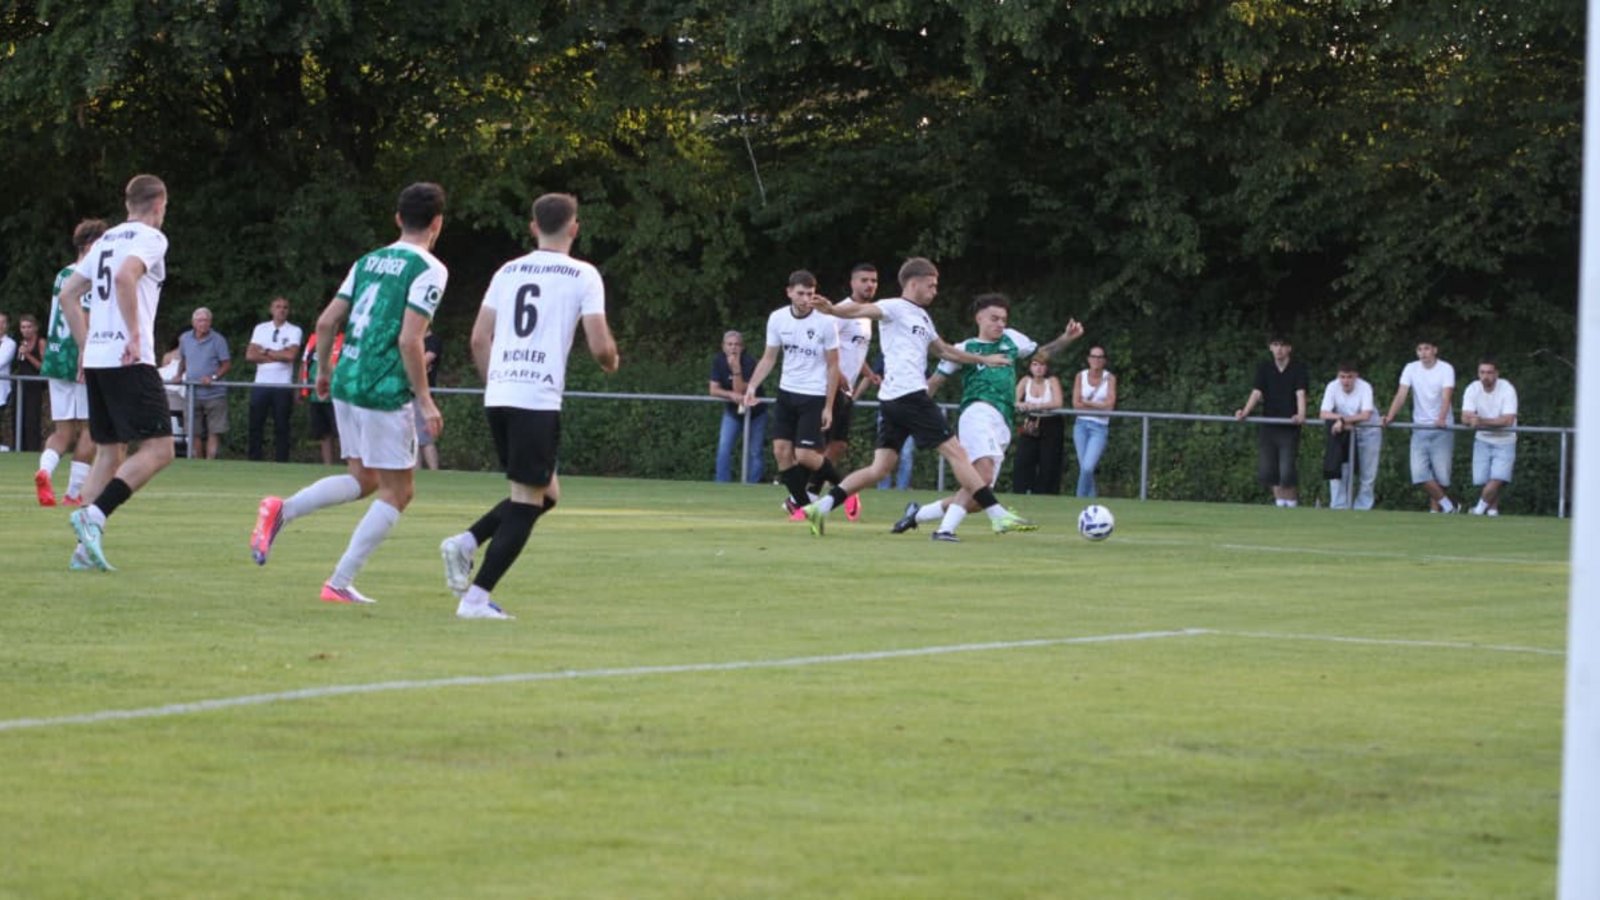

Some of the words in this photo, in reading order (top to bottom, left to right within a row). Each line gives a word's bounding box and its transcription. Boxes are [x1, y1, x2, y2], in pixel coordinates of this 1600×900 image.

[97, 249, 114, 301] 5
[349, 282, 381, 339] 4
[514, 283, 541, 338] 6
